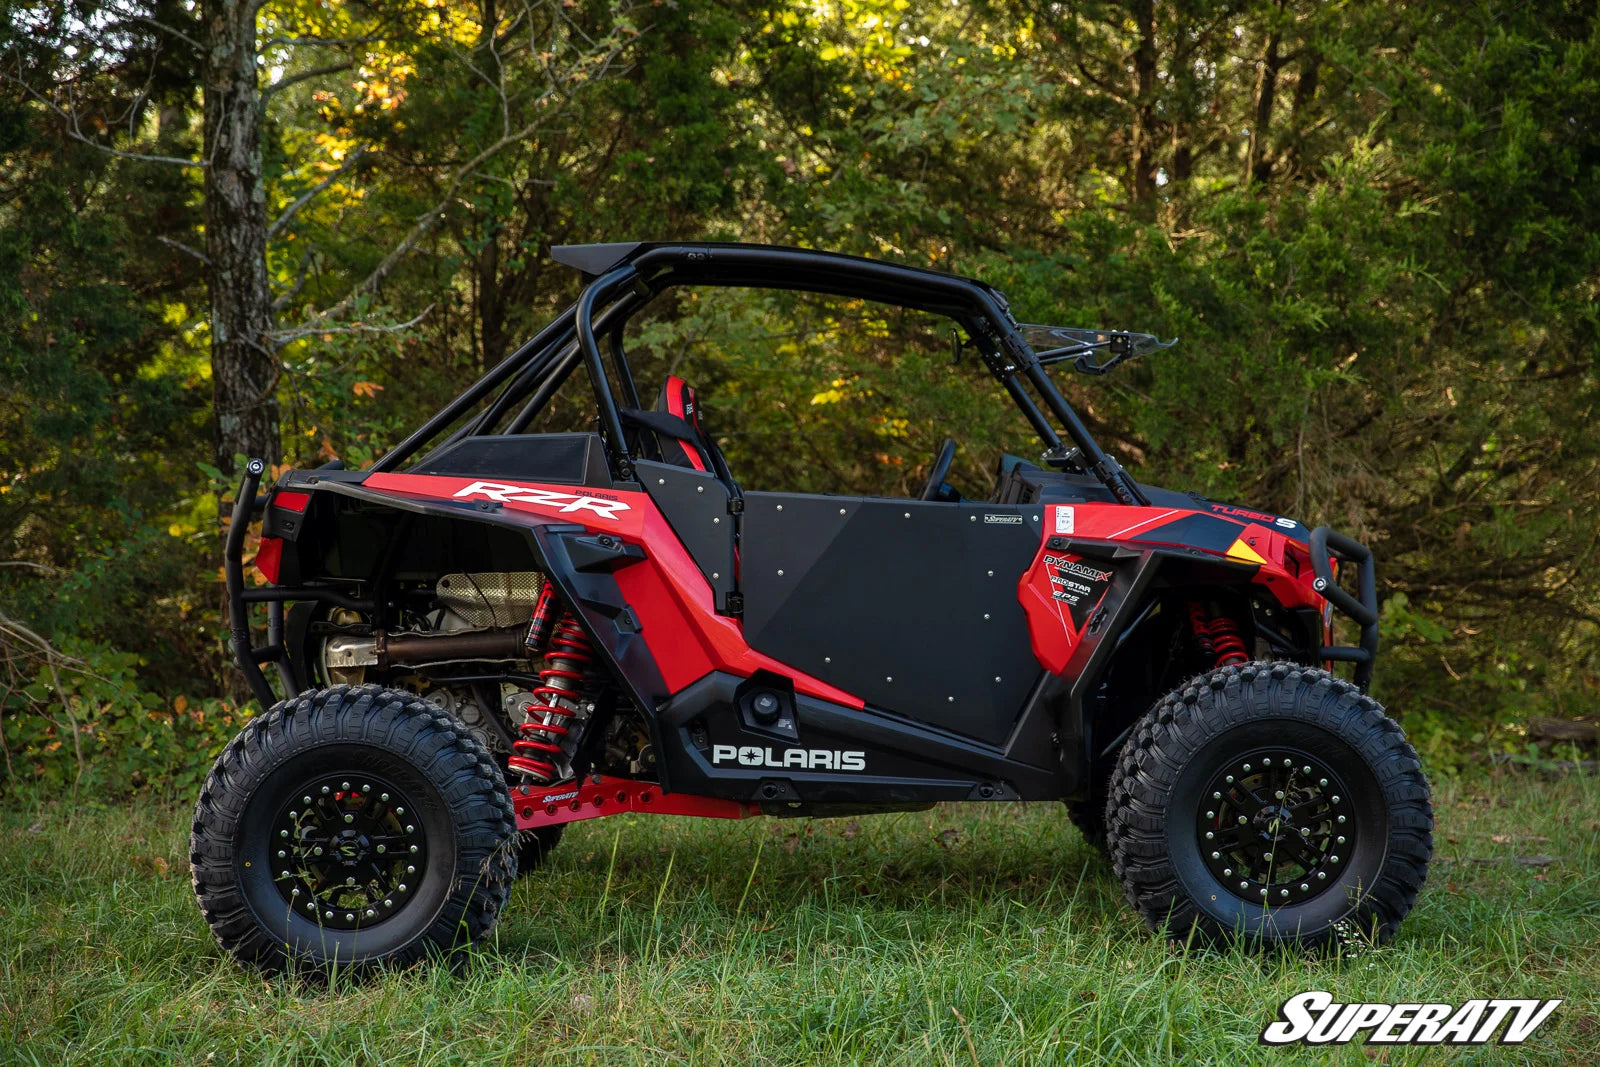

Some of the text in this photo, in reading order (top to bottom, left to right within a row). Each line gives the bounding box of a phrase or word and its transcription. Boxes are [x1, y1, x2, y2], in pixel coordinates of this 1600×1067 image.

[453, 481, 631, 520] RZR
[575, 489, 619, 501] POLARIS
[1211, 504, 1297, 529] TURBO S
[1043, 555, 1113, 582] DYNAMIX
[712, 744, 866, 771] POLARIS
